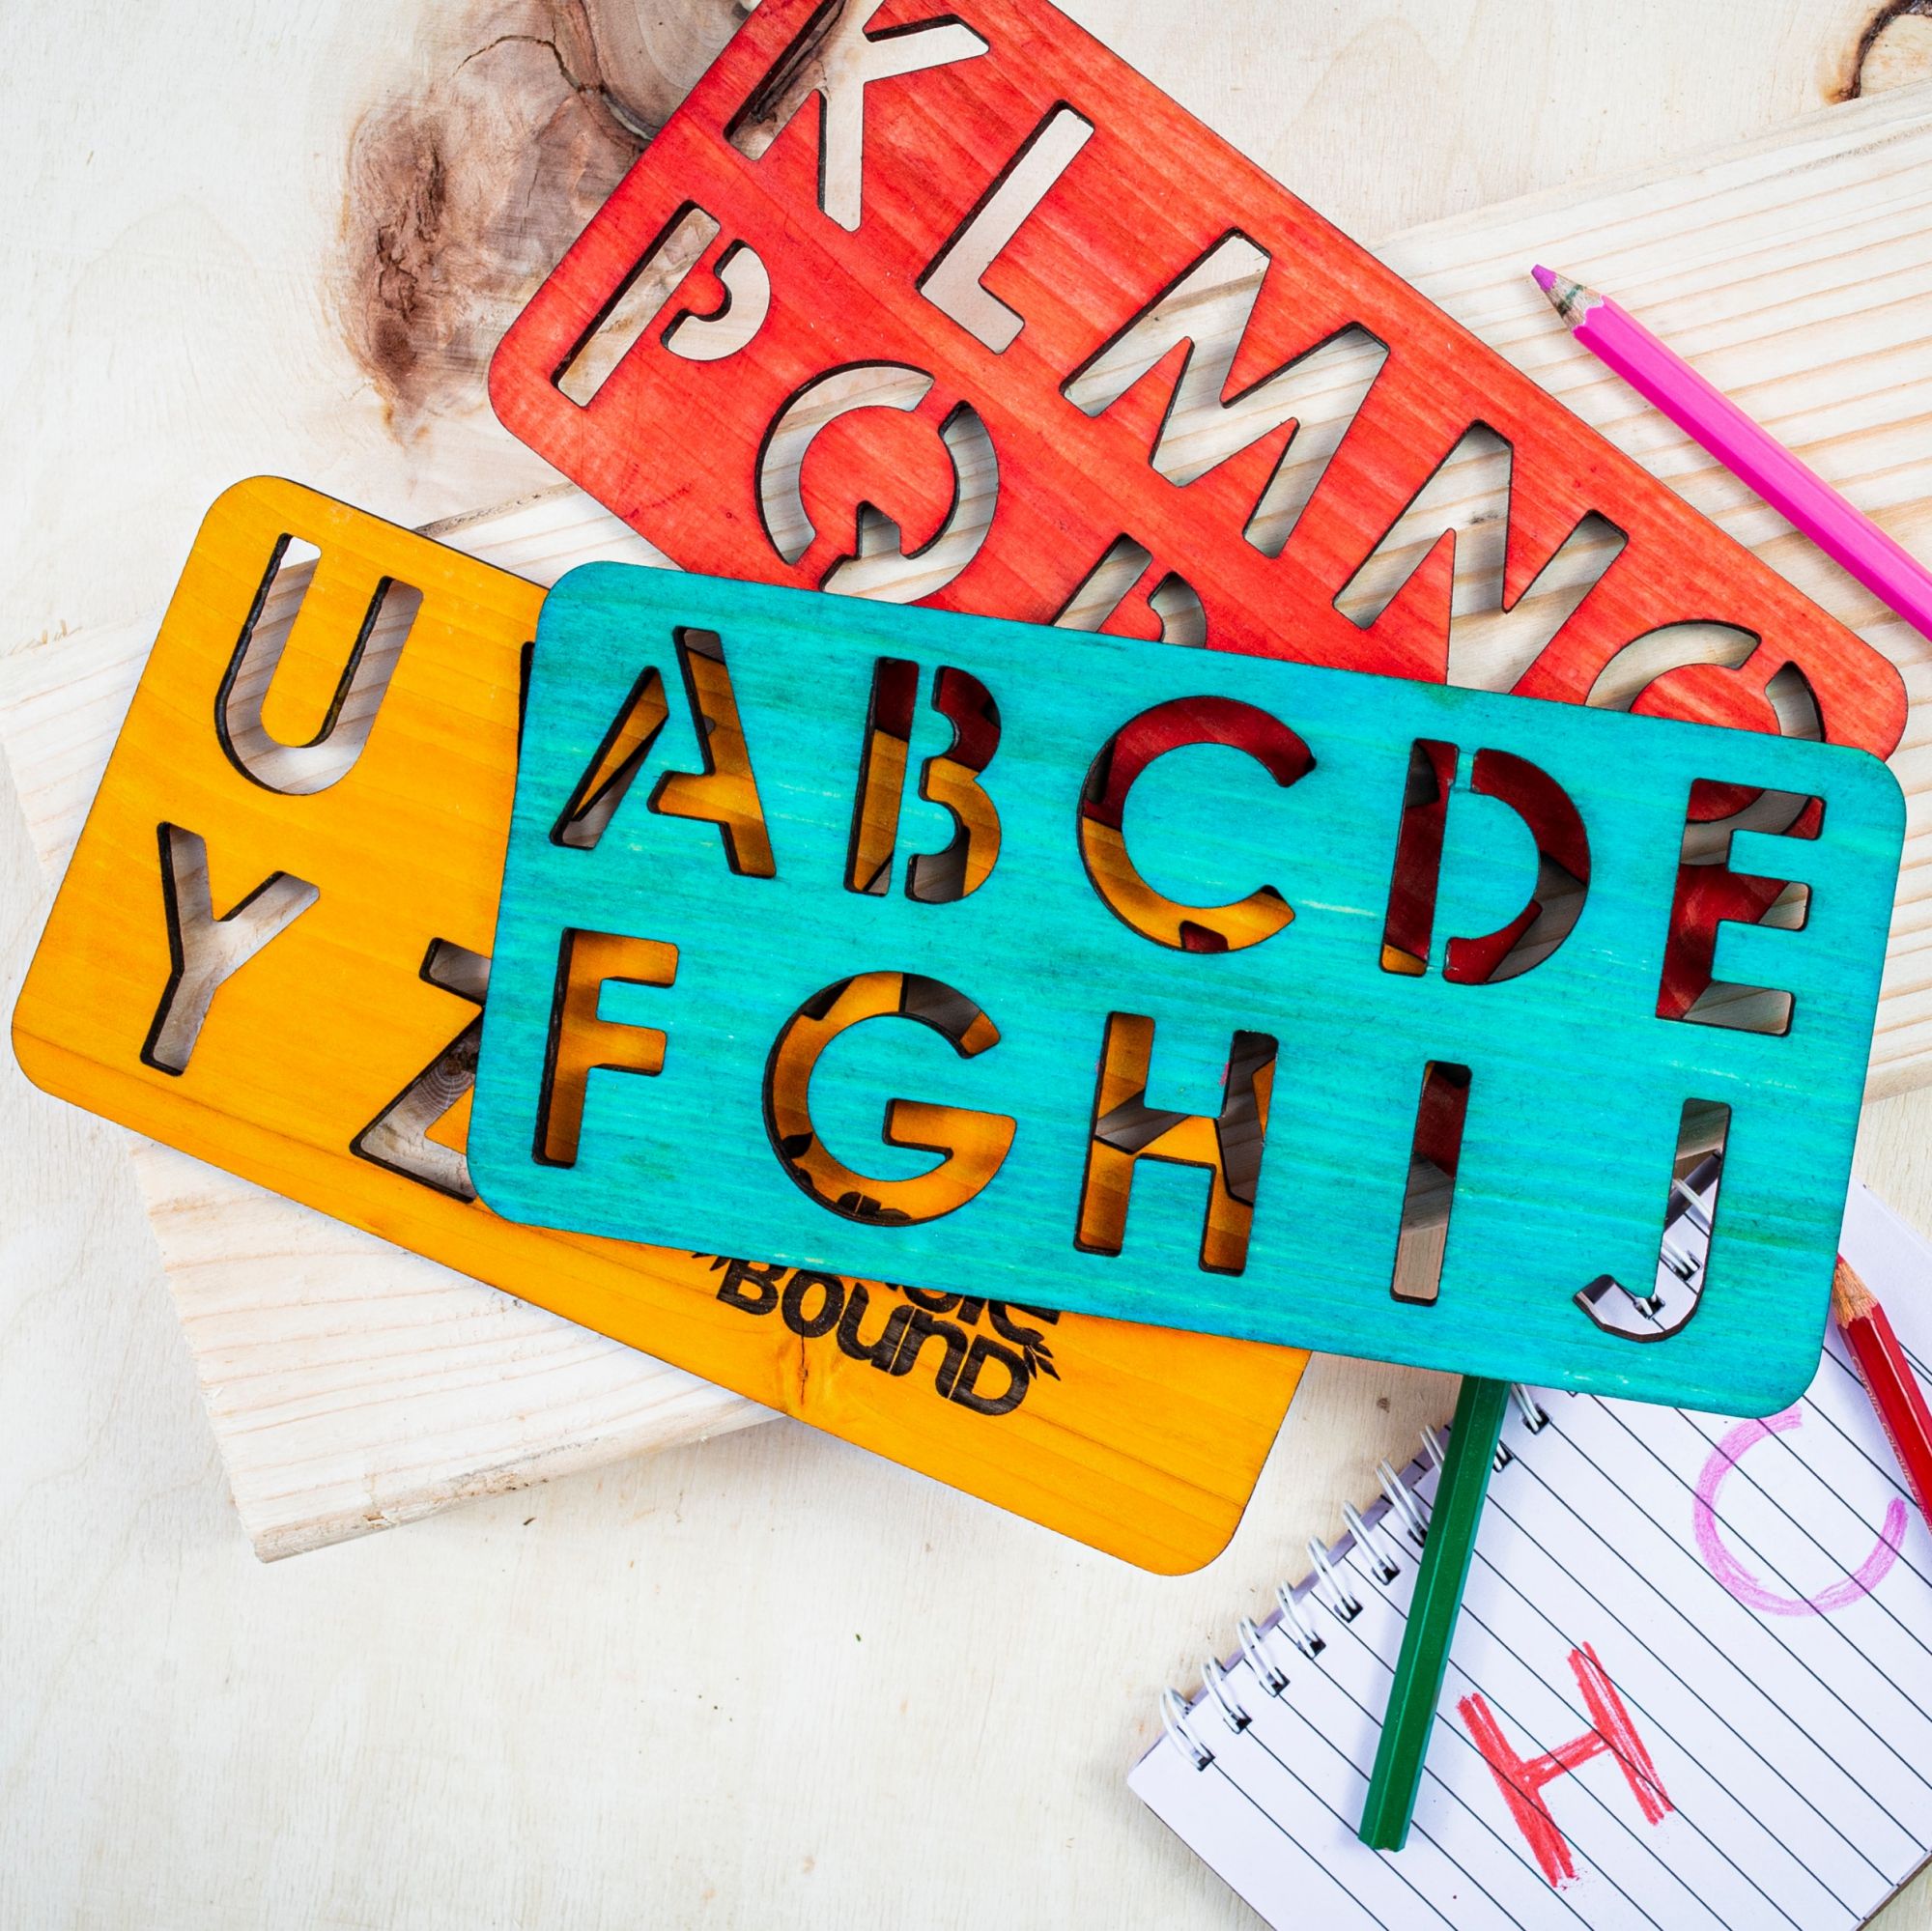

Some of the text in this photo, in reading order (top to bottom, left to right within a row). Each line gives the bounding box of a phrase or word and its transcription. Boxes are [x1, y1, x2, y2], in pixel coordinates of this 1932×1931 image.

[551, 199, 772, 410] P
[915, 99, 1095, 355] L
[1060, 227, 1391, 560] M
[1332, 419, 1630, 694] N
[214, 532, 425, 797] U
[140, 821, 321, 1077] Y
[549, 626, 777, 880] A
[843, 657, 1002, 904] B
[1076, 696, 1317, 953] C
[1378, 738, 1592, 985] D
[1656, 779, 1827, 1036] E
[531, 927, 679, 1168] F
[762, 971, 1017, 1227] G
[1073, 1010, 1278, 1276] H
[1573, 1097, 1732, 1343] J
[1458, 1641, 1675, 1890] H
